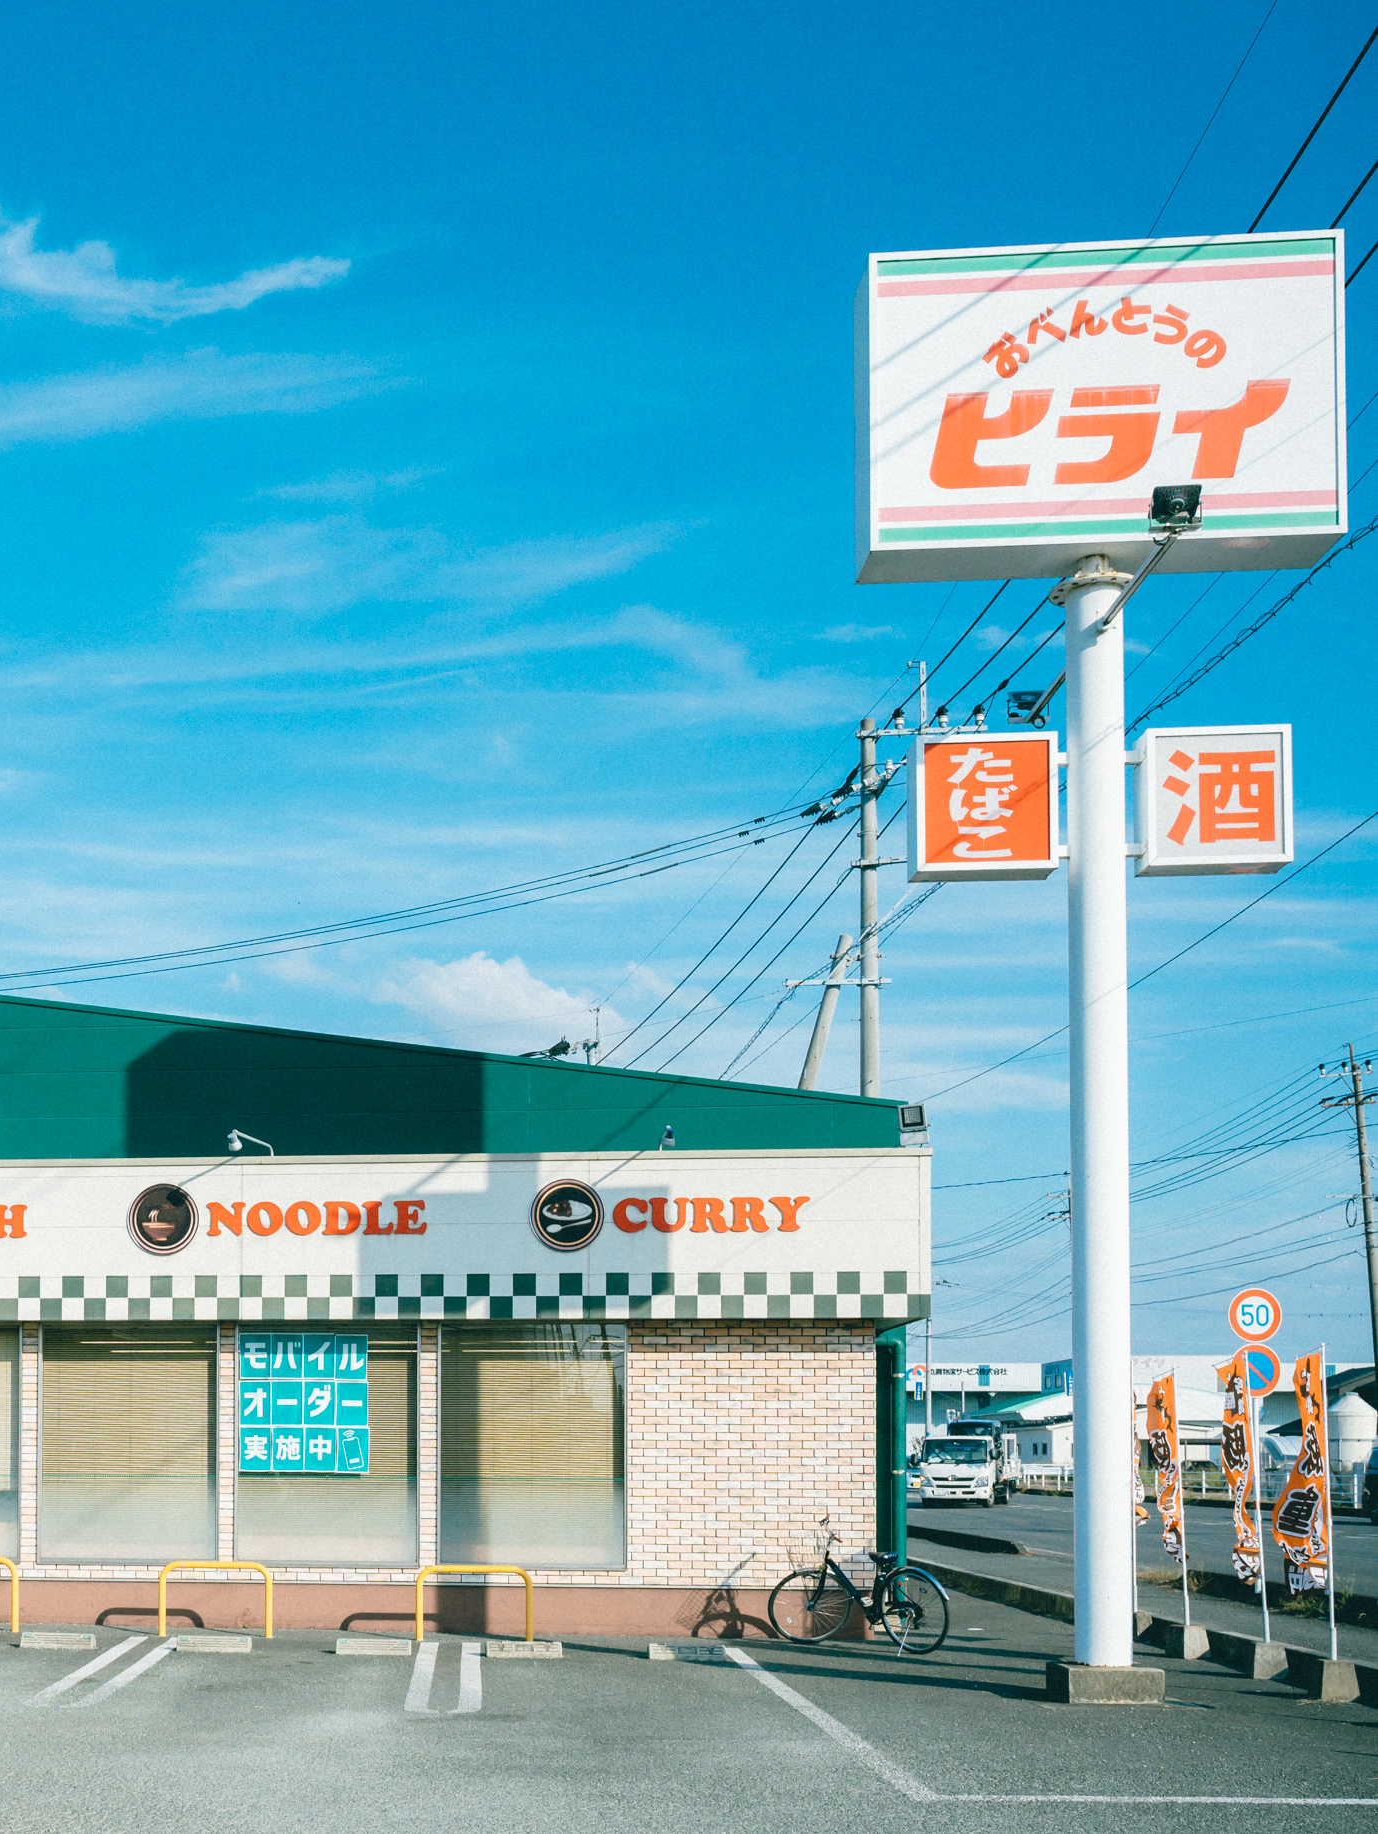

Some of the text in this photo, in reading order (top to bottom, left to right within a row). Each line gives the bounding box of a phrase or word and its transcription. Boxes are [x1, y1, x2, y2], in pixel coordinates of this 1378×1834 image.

[983, 297, 1228, 380] おべんとうの
[929, 377, 1291, 490] ヒライ
[948, 747, 1015, 859] たばこ
[1162, 748, 1277, 846] 酒
[206, 1200, 429, 1238] NOODLE
[612, 1196, 811, 1234] CURRY
[1240, 1303, 1270, 1328] 50
[243, 1341, 365, 1372] モバイル
[243, 1384, 364, 1419] オーダー
[243, 1434, 333, 1462] 実施中
